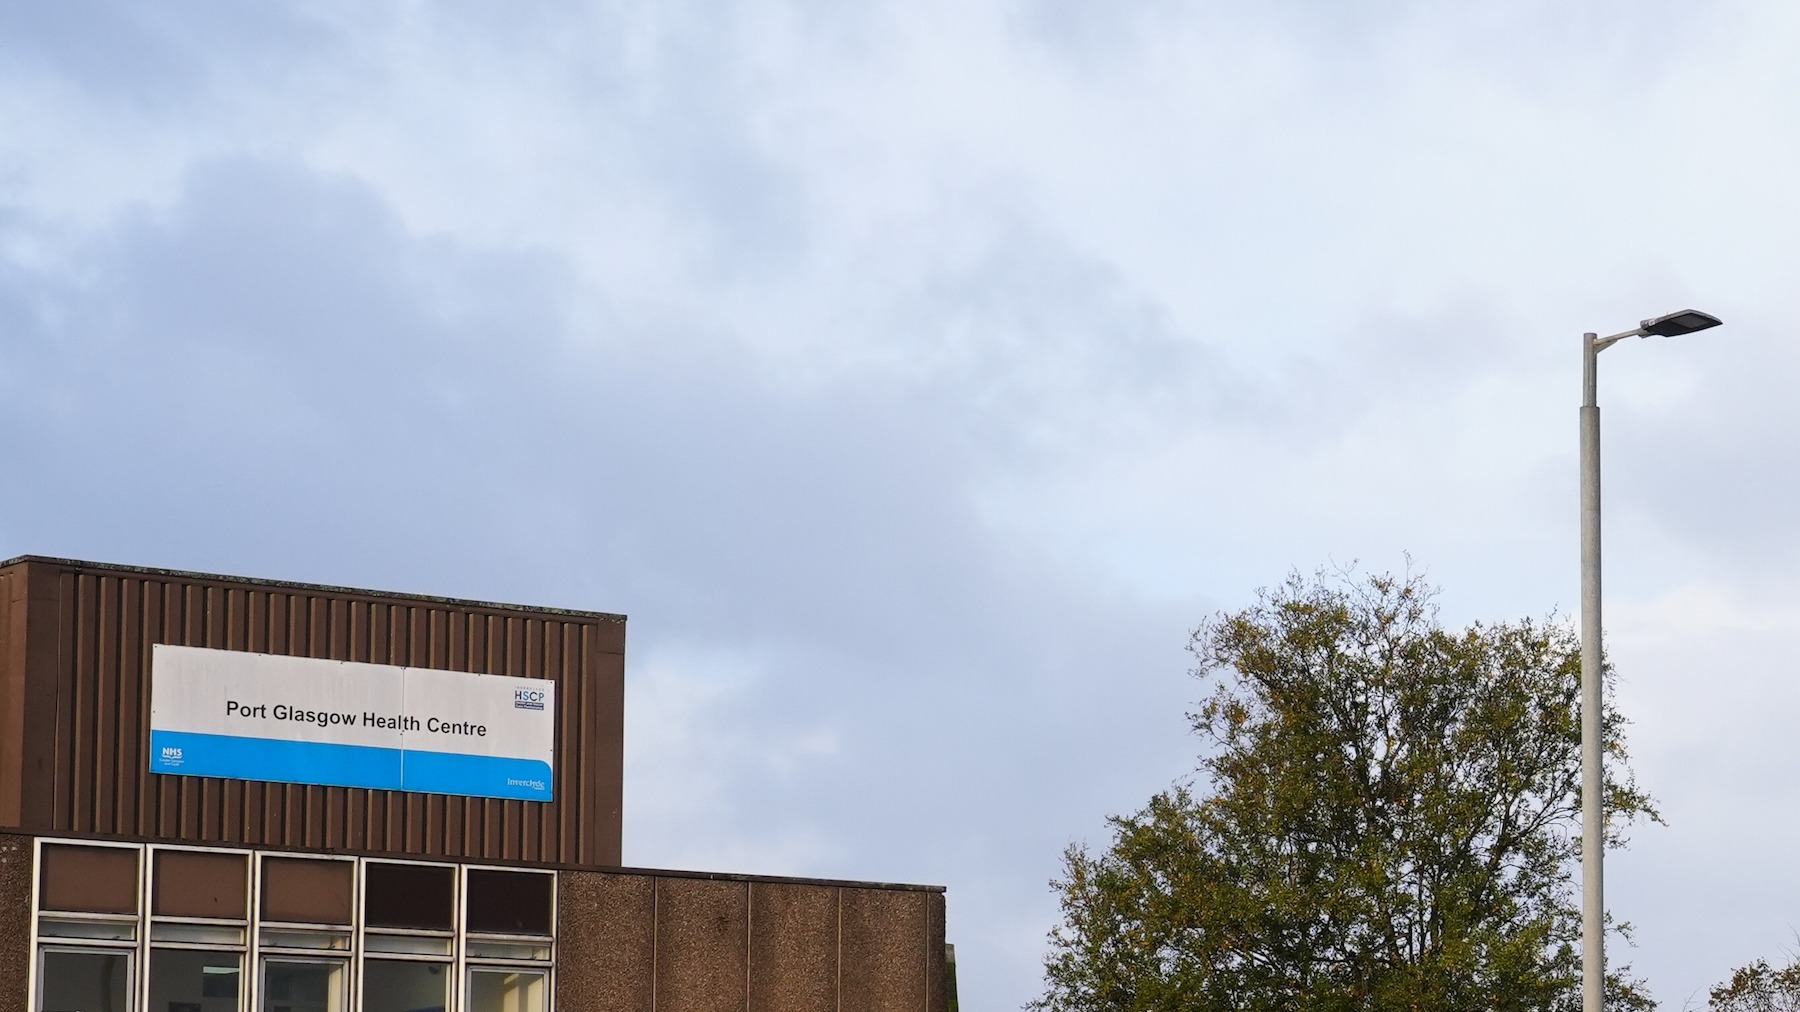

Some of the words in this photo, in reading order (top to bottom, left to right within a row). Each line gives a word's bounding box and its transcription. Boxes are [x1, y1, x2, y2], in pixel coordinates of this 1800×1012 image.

[515, 690, 544, 701] HSCP
[226, 701, 267, 719] Port
[273, 704, 357, 727] Glasgow
[363, 712, 420, 731] Health
[427, 717, 487, 737] Centre
[162, 746, 183, 756] NHS
[507, 777, 545, 788] Inverclyde
